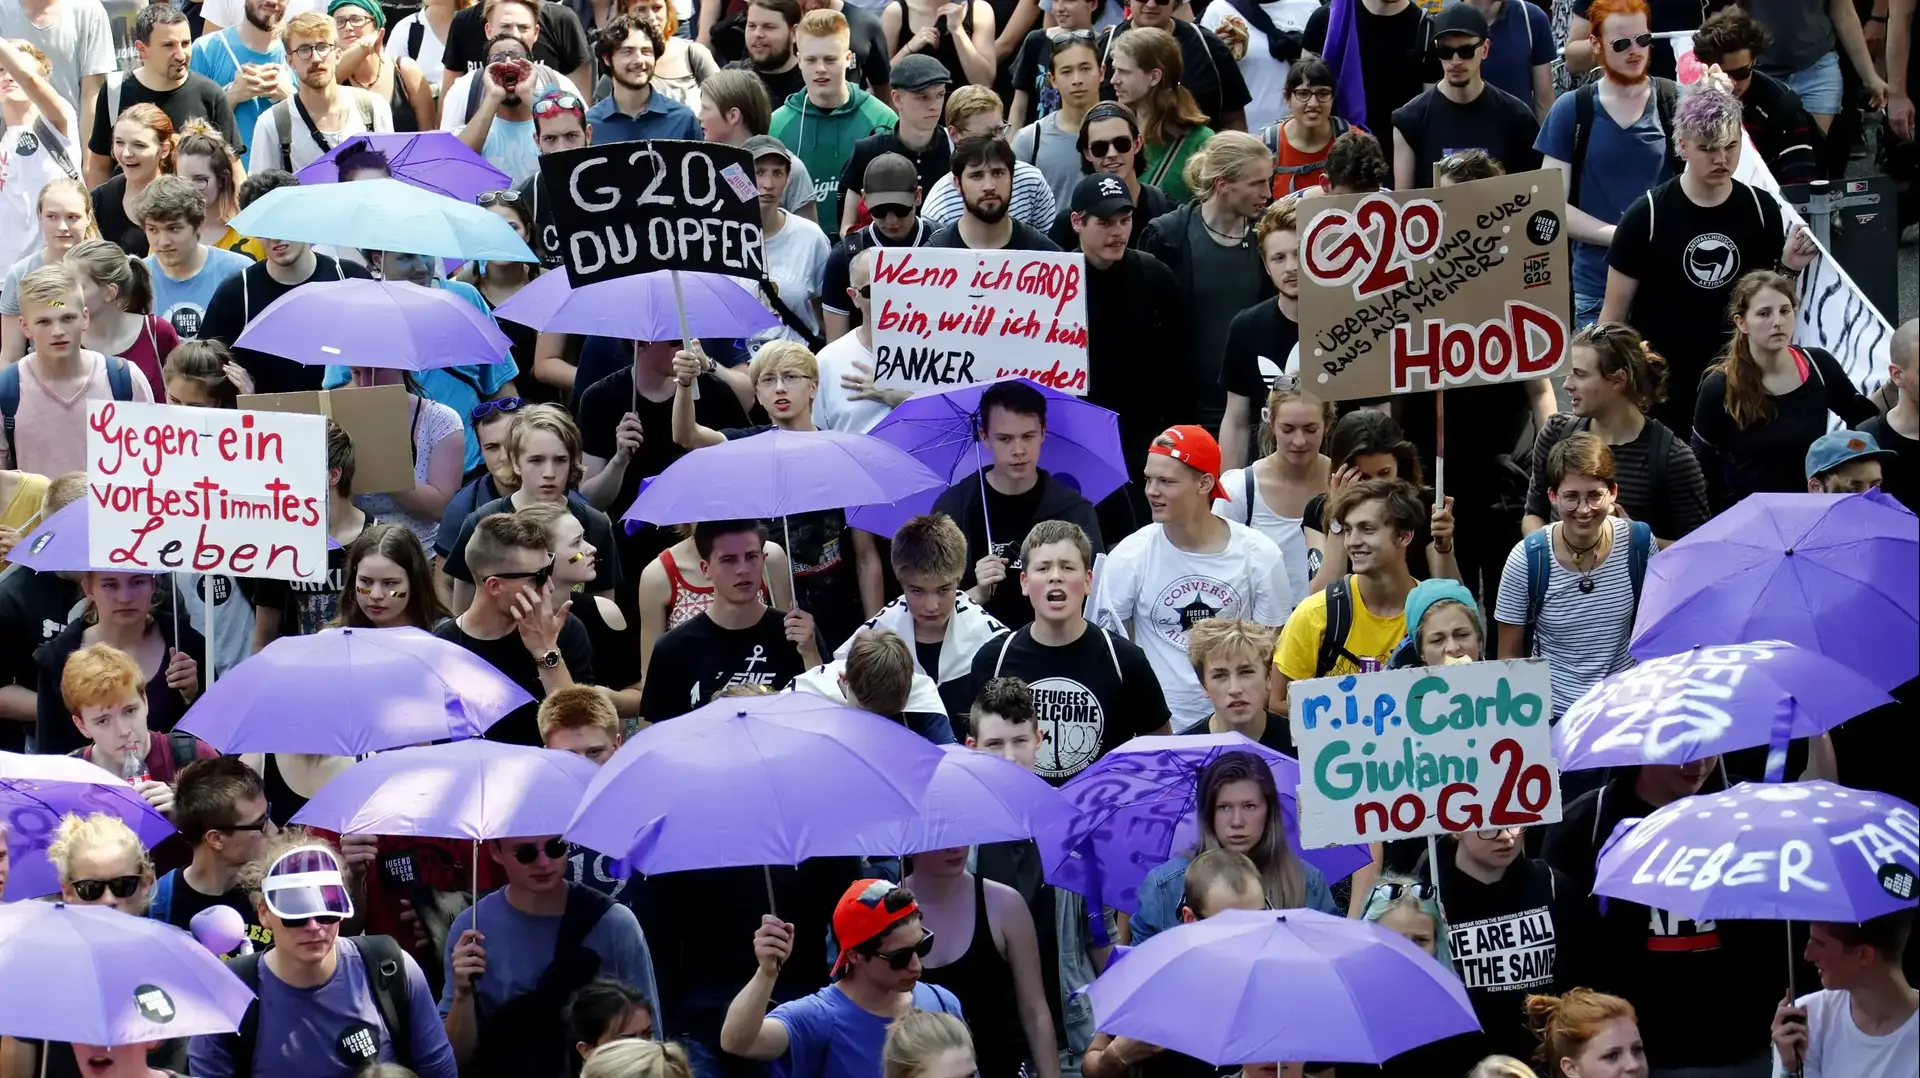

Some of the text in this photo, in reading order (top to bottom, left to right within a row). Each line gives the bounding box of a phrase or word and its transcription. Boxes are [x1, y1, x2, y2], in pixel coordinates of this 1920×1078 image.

[569, 150, 724, 212] G20,
[1534, 215, 1557, 227] JUGEND
[1535, 223, 1555, 234] GEGEN
[570, 223, 638, 275] DU
[648, 217, 768, 280] OPFER!
[1303, 197, 1441, 298] G20
[1435, 230, 1471, 260] UND
[873, 250, 958, 289] Wenn
[970, 260, 1013, 290] ich
[1523, 257, 1550, 273] HDF
[1523, 271, 1552, 284] G20
[1698, 278, 1724, 287] AKTION
[877, 299, 1088, 349] bin, will ich kein
[1323, 339, 1372, 376] RAUS
[1373, 309, 1410, 341] AUS
[873, 345, 975, 386] BANKER
[1392, 301, 1566, 391] HOOD
[90, 402, 284, 477] Gegen ein
[90, 476, 320, 527] vorbestimmtes
[108, 515, 315, 577] Leben
[1163, 581, 1234, 607] CONVERSE
[1186, 609, 1210, 617] JUGEND
[1165, 629, 1187, 645] ALL
[1033, 702, 1099, 723] ELCOME
[1302, 675, 1402, 736] r.i.p.
[1405, 676, 1543, 736] Carlo
[1354, 793, 1426, 836] no
[1437, 738, 1552, 833] G20
[385, 856, 411, 869] JUGEND
[390, 864, 413, 876] GEGEN
[1631, 838, 1830, 892] LIEBER
[1476, 922, 1517, 954] ARE
[1519, 914, 1553, 945] ALL
[1464, 947, 1556, 986] THE SAME
[1487, 985, 1502, 993] KEIN
[1502, 980, 1529, 991] MENSCH
[342, 1028, 370, 1048] JUGEND
[349, 1036, 373, 1053] GEGEN
